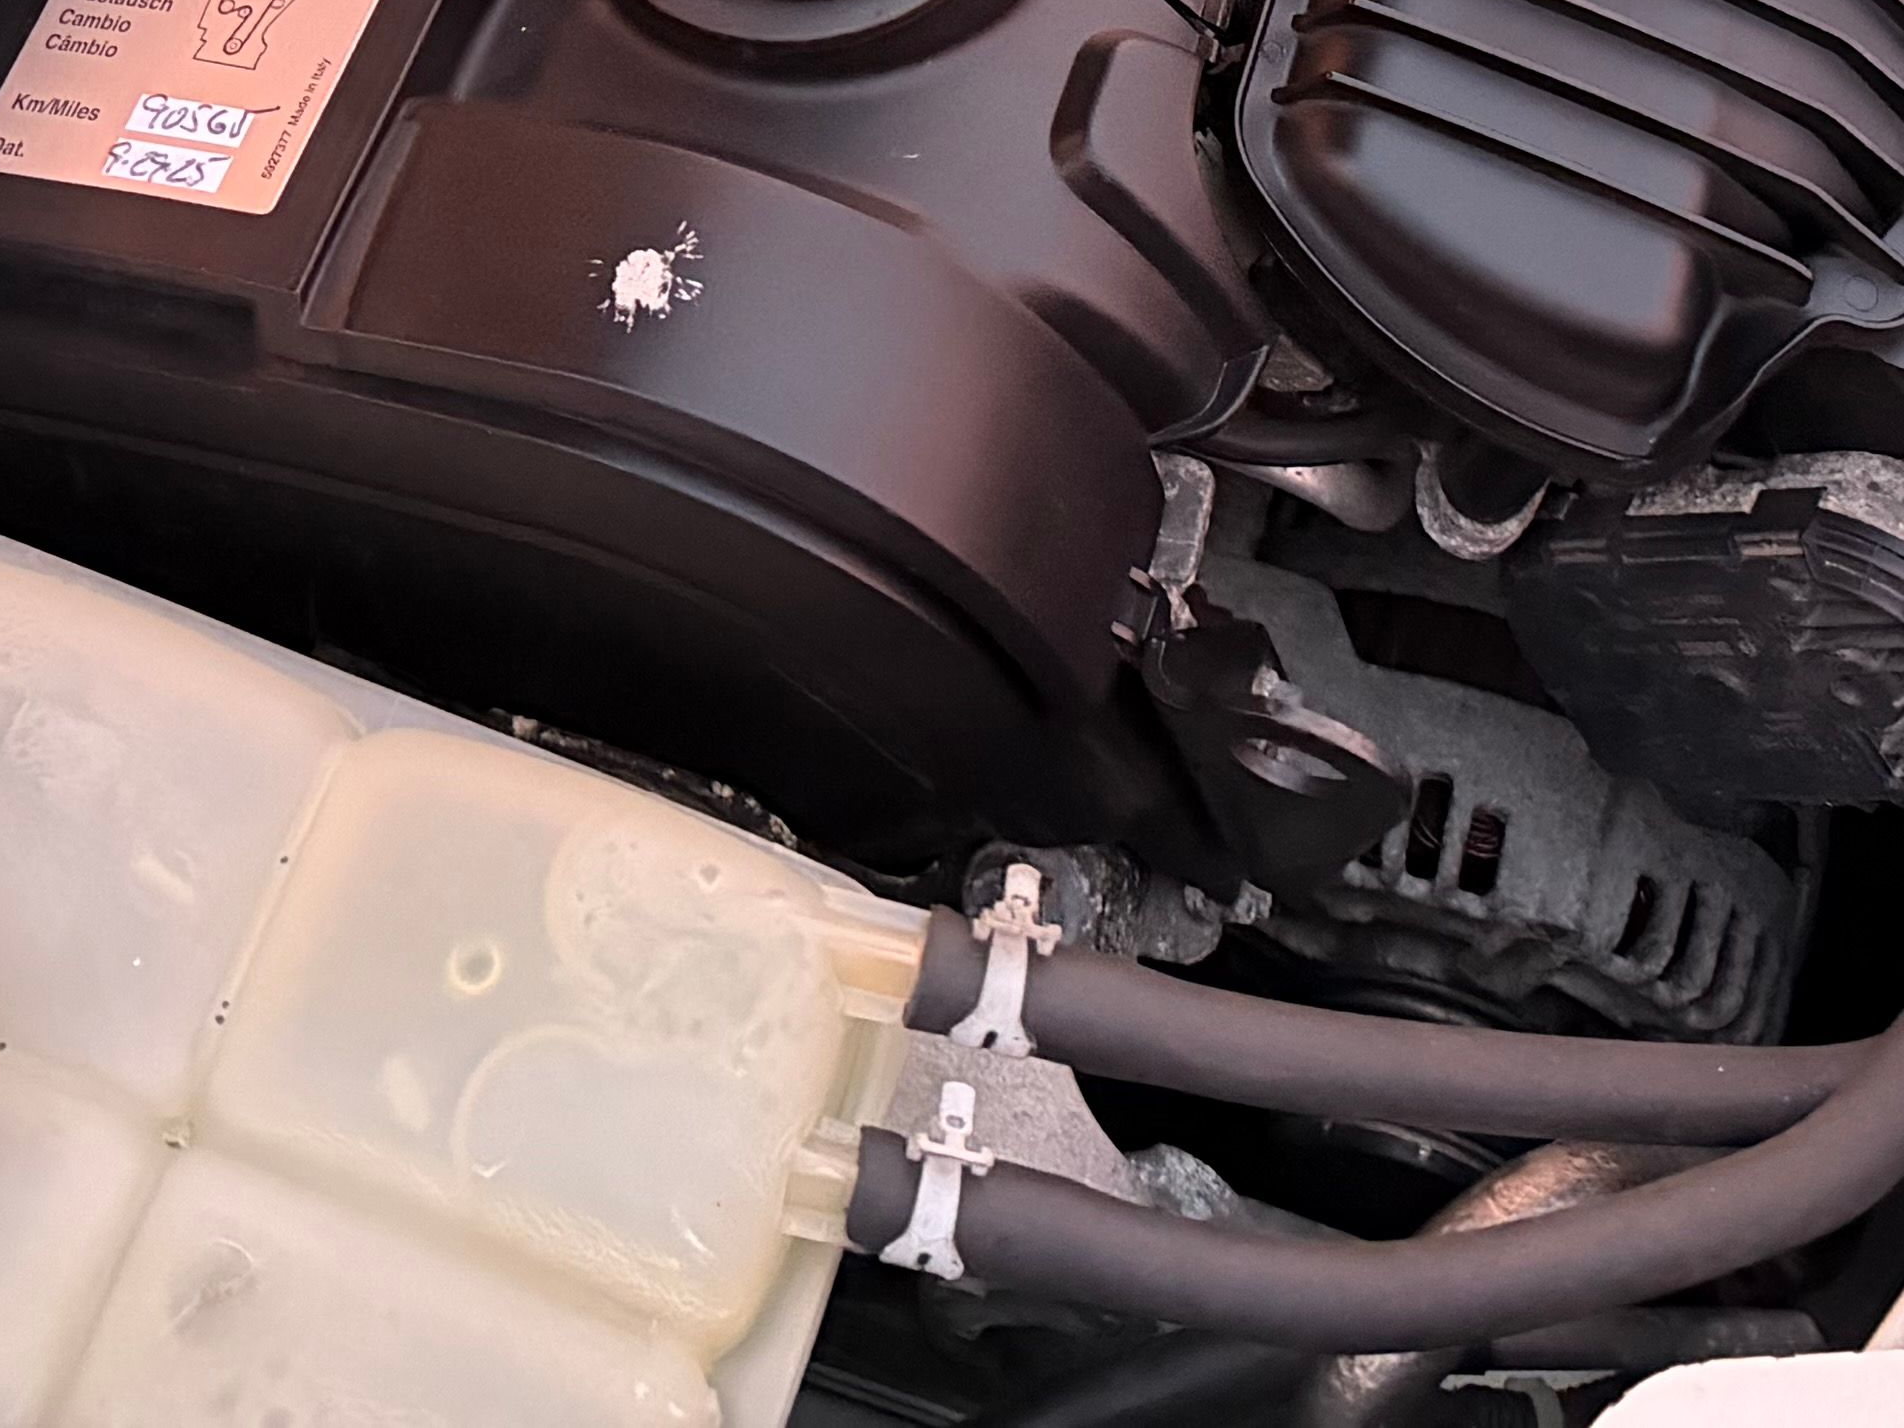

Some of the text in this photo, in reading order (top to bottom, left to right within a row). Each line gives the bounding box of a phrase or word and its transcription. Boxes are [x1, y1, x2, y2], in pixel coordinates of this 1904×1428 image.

[59, 9, 131, 33] Cambio
[45, 33, 118, 58] Câmbio
[288, 95, 312, 126] Made
[311, 56, 332, 84] Italy
[11, 93, 100, 122] Km/Miles
